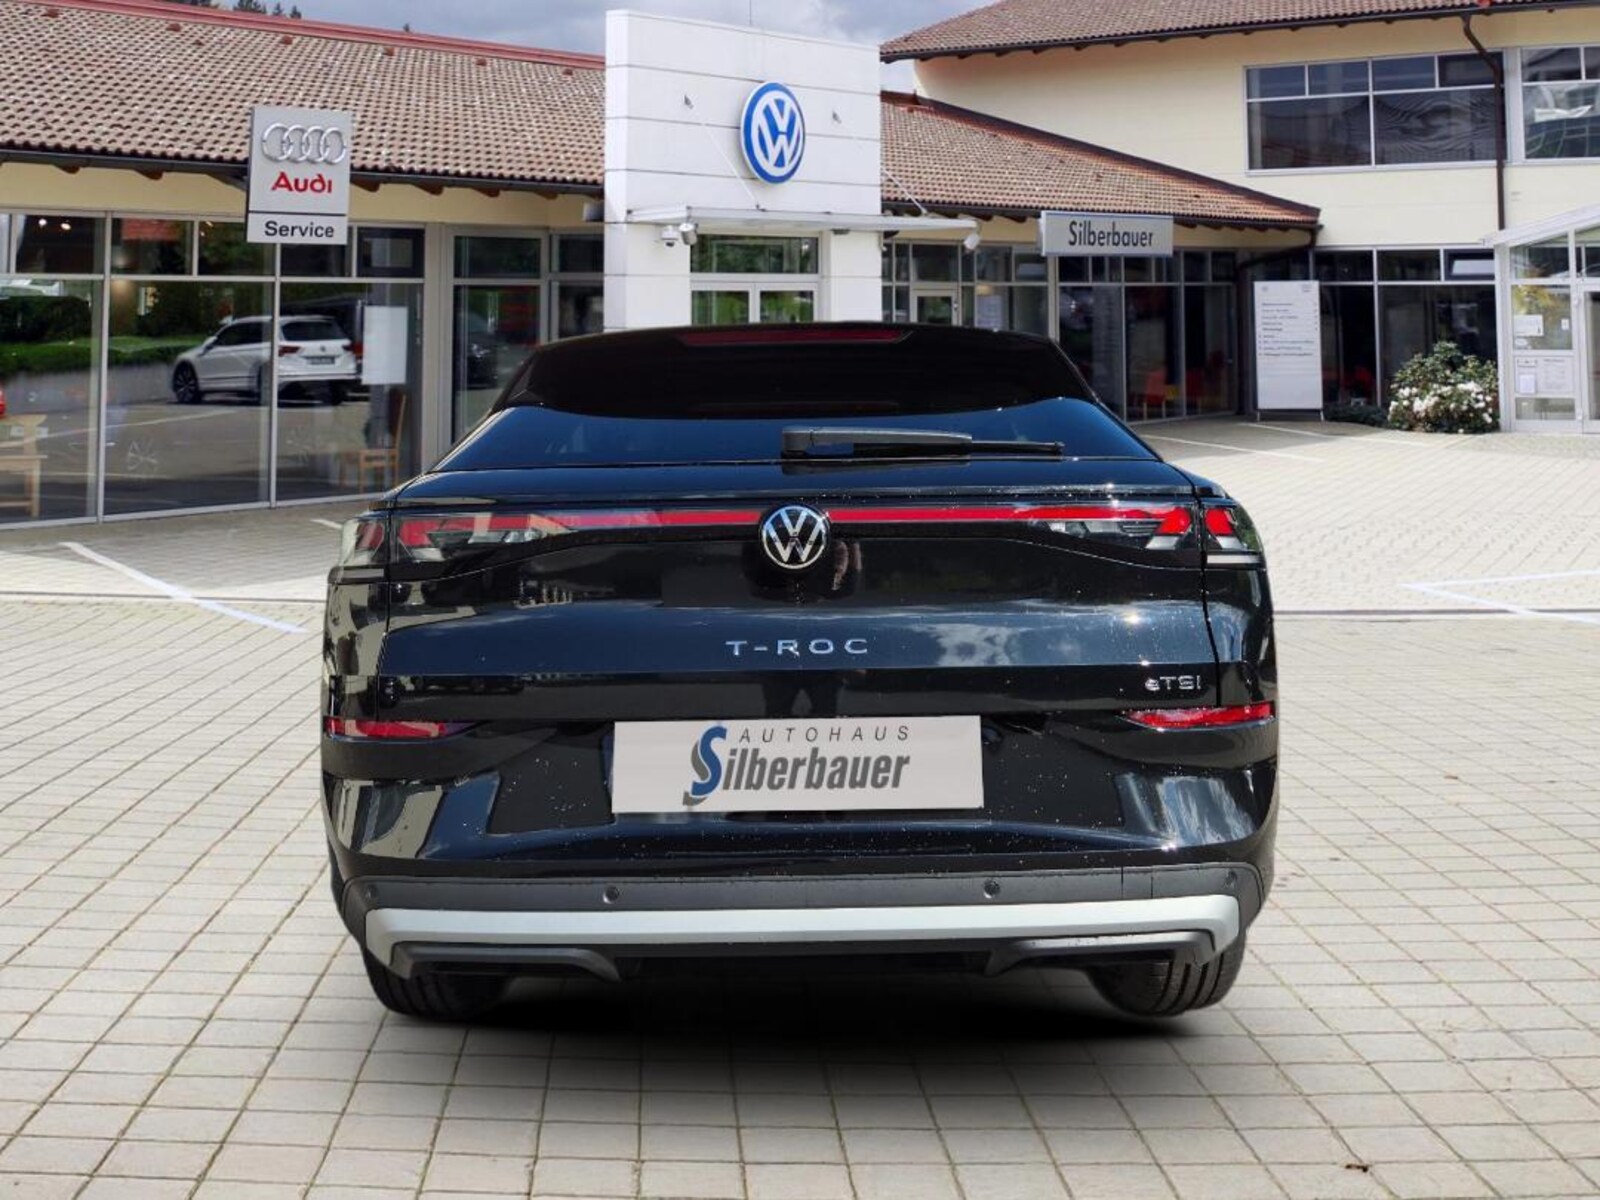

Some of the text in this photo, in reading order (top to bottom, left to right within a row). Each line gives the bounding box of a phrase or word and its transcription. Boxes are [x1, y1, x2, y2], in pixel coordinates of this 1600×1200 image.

[271, 171, 332, 194] Audi
[264, 220, 335, 238] Service
[1068, 220, 1154, 247] Silberbauer
[763, 505, 826, 569] VW
[725, 638, 868, 656] T-ROC
[1144, 674, 1201, 692] eTSI
[738, 725, 909, 744] AUTOHAUS
[687, 725, 910, 800] Silberbauer
